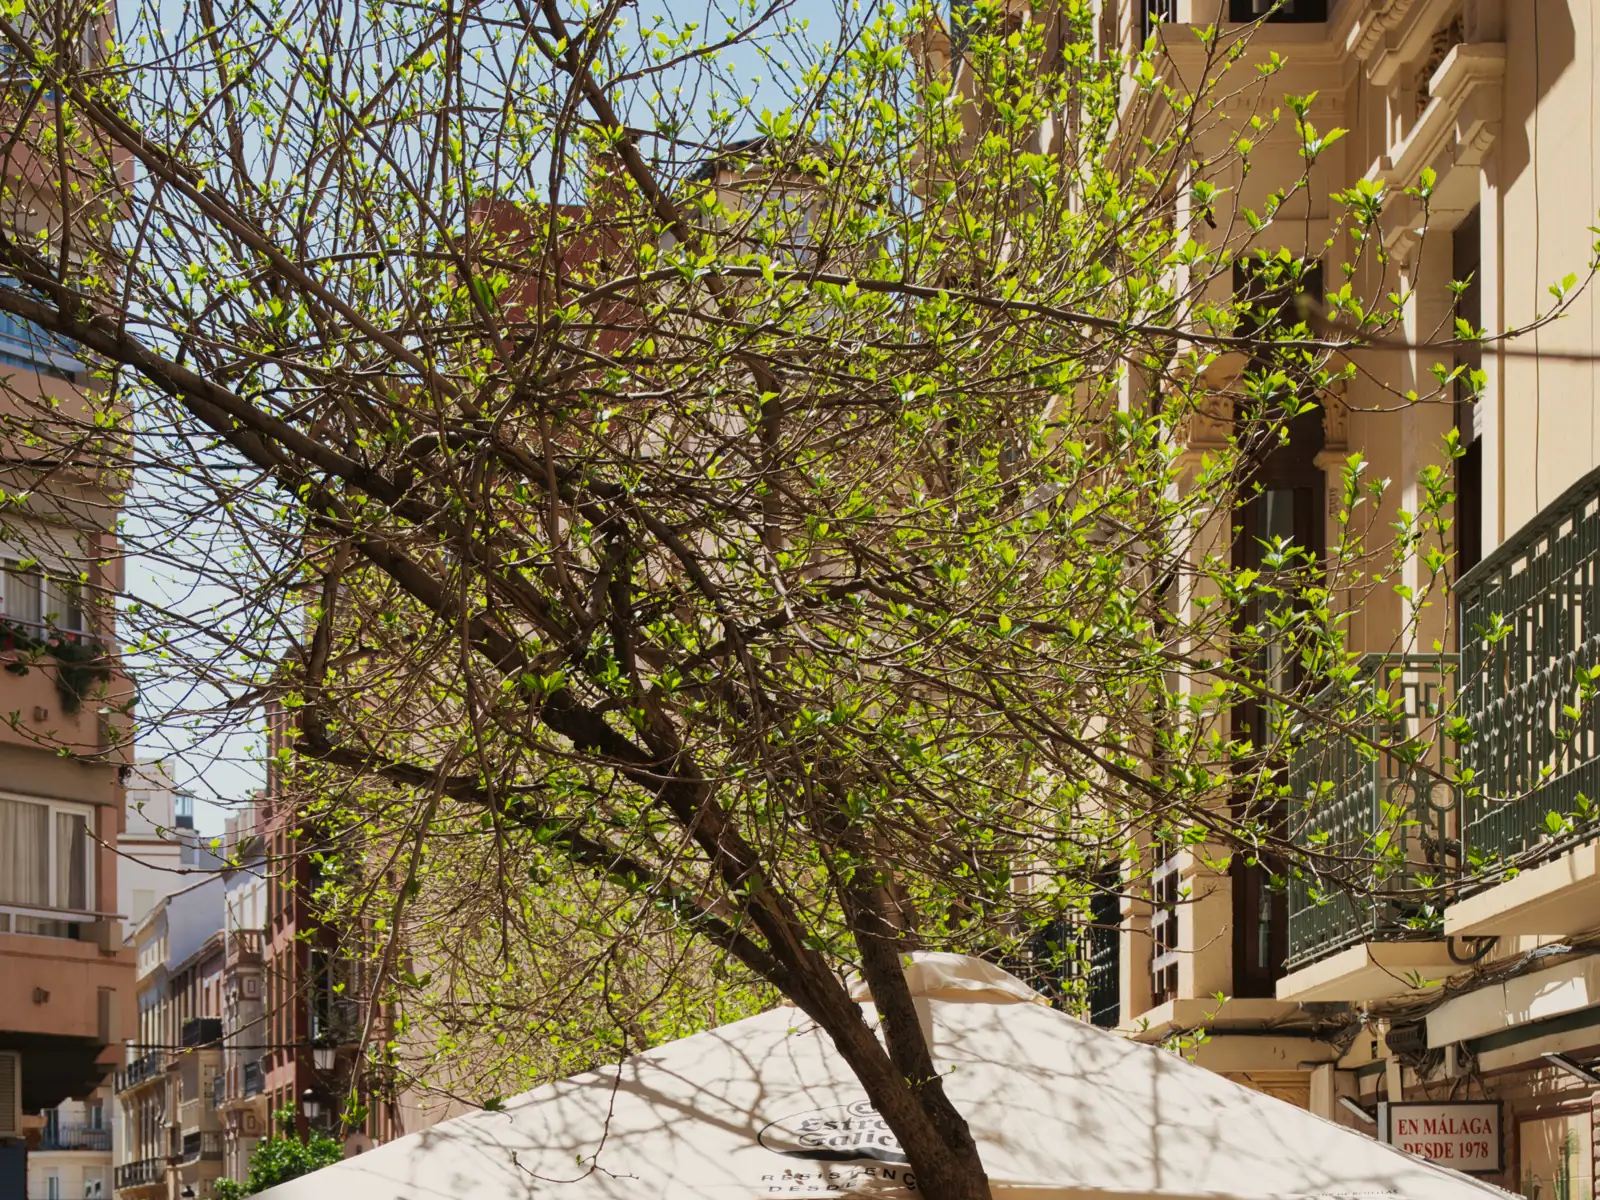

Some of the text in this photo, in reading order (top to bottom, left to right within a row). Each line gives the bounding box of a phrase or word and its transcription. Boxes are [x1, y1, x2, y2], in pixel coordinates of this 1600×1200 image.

[799, 1117, 890, 1132] Estre
[1397, 1112, 1493, 1136] EN MÁLAGA
[798, 1130, 902, 1148] Galic
[1459, 1141, 1490, 1159] 1978
[761, 1166, 917, 1187] RESISTENC
[768, 1180, 858, 1192] DESDE
